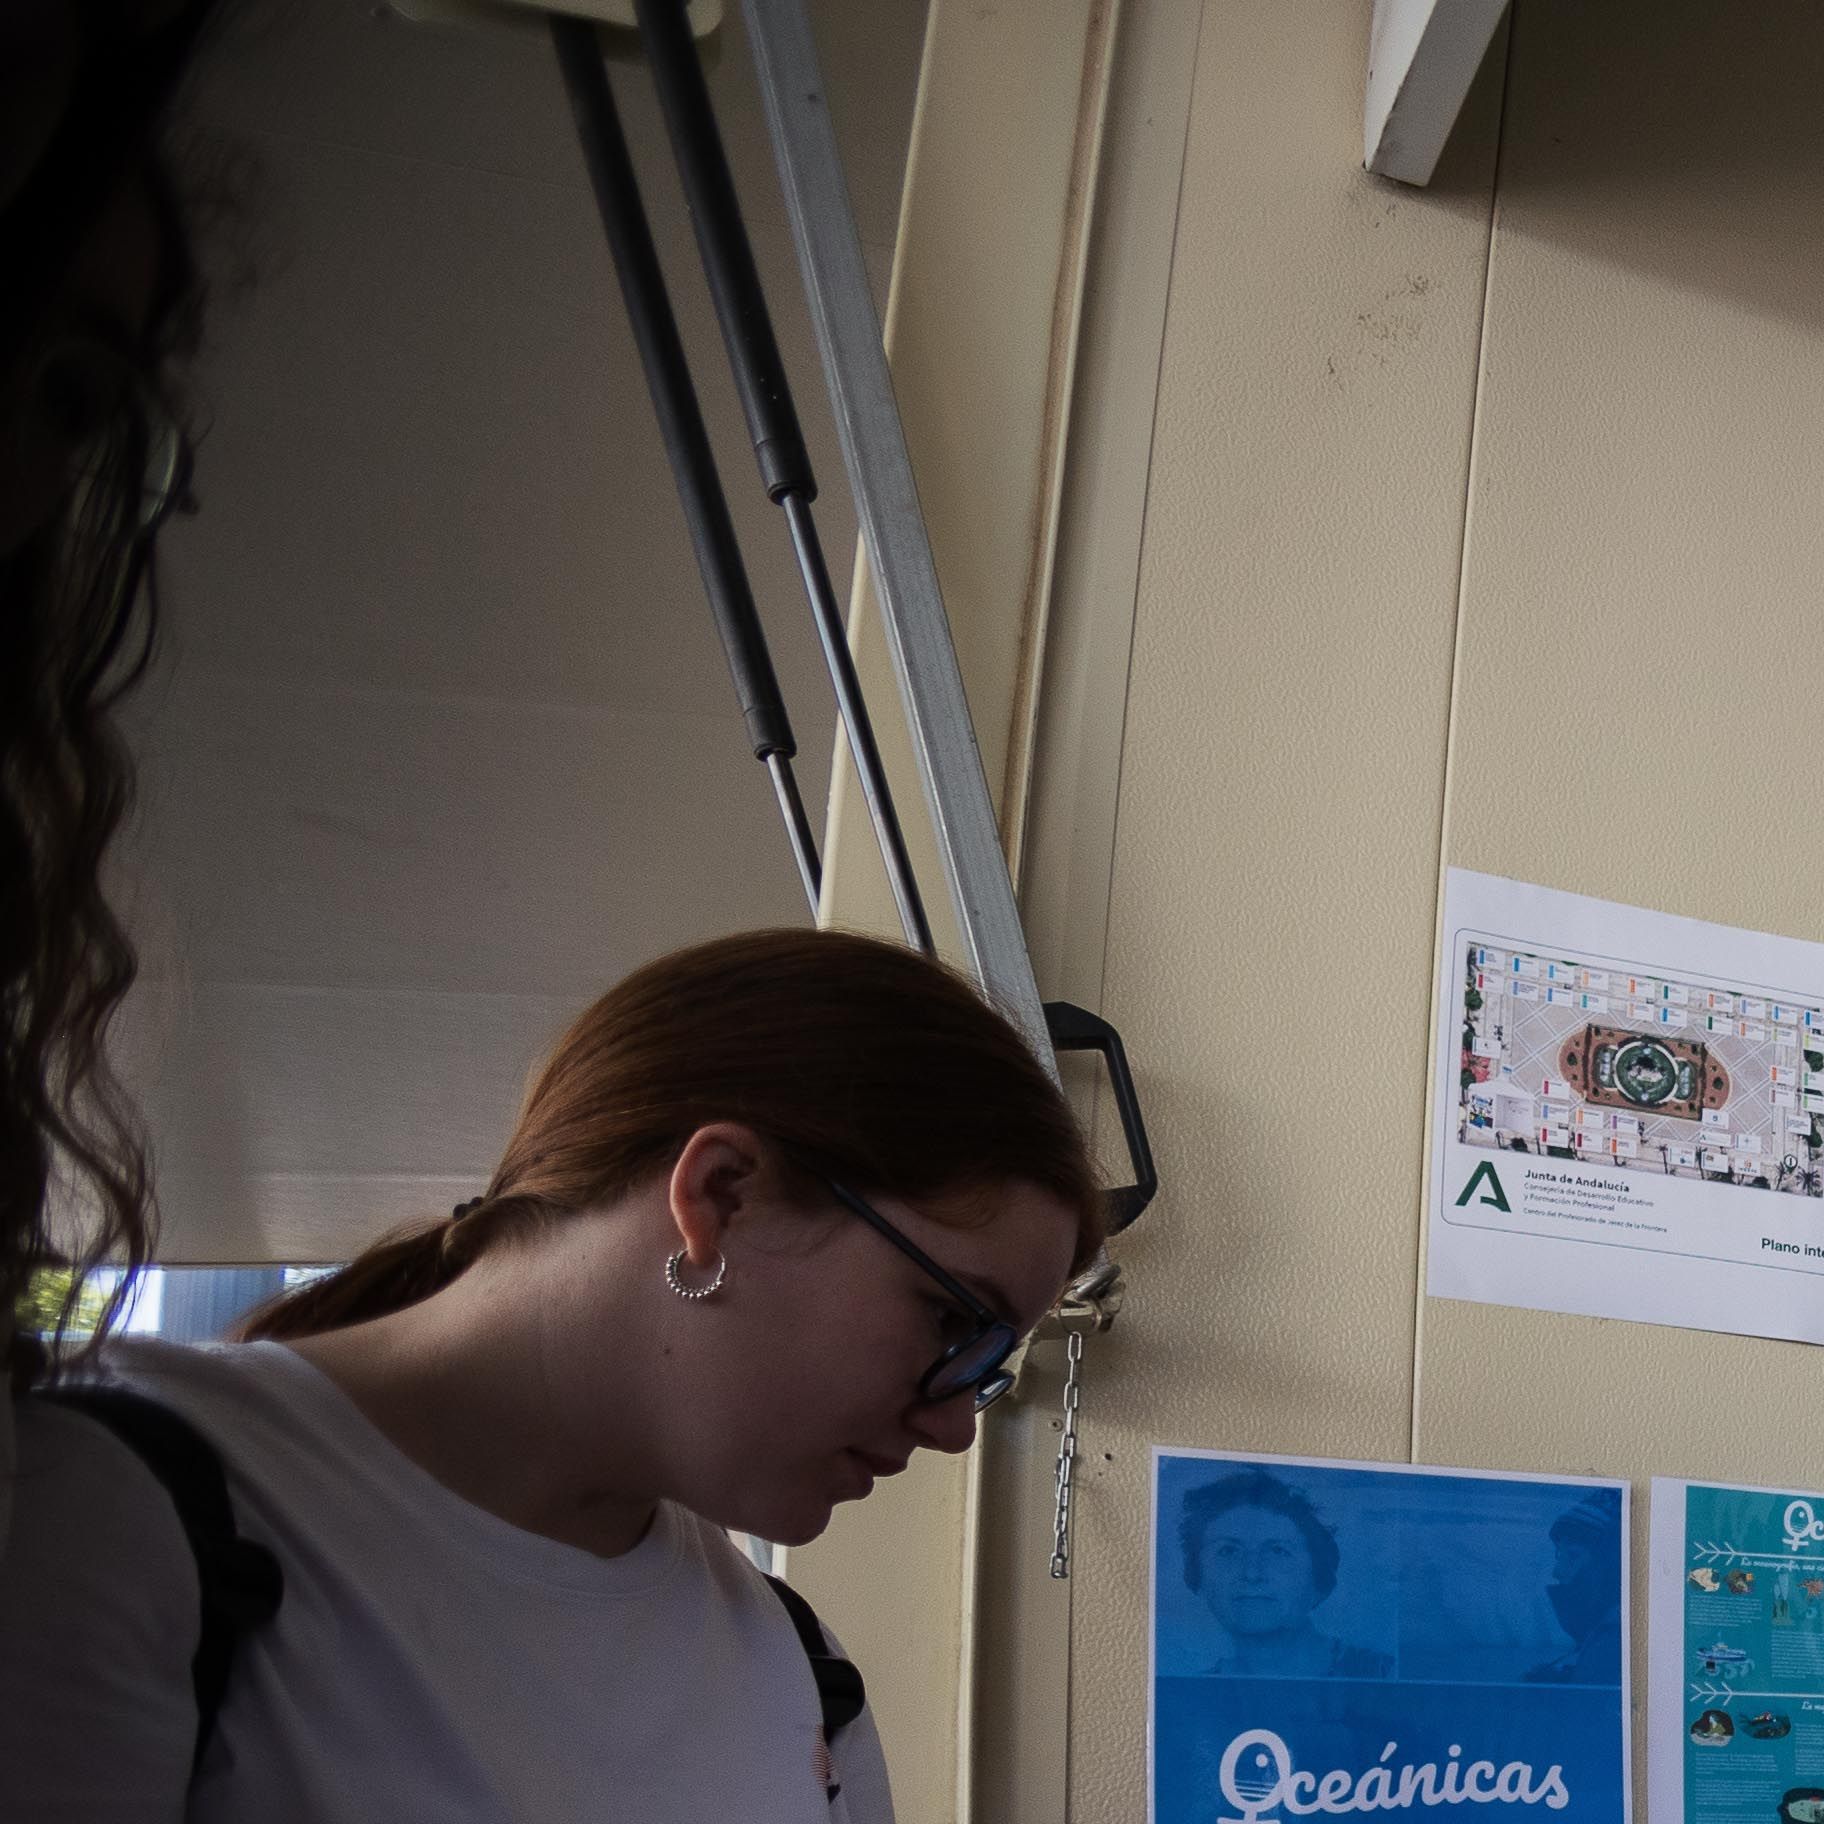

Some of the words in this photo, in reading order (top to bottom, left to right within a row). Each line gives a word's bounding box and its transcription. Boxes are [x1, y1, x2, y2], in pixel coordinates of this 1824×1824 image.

[1524, 1168, 1557, 1183] Junta
[1559, 1173, 1574, 1185] de
[1575, 1175, 1630, 1193] Andalucía
[1761, 1237, 1800, 1255] Plano
